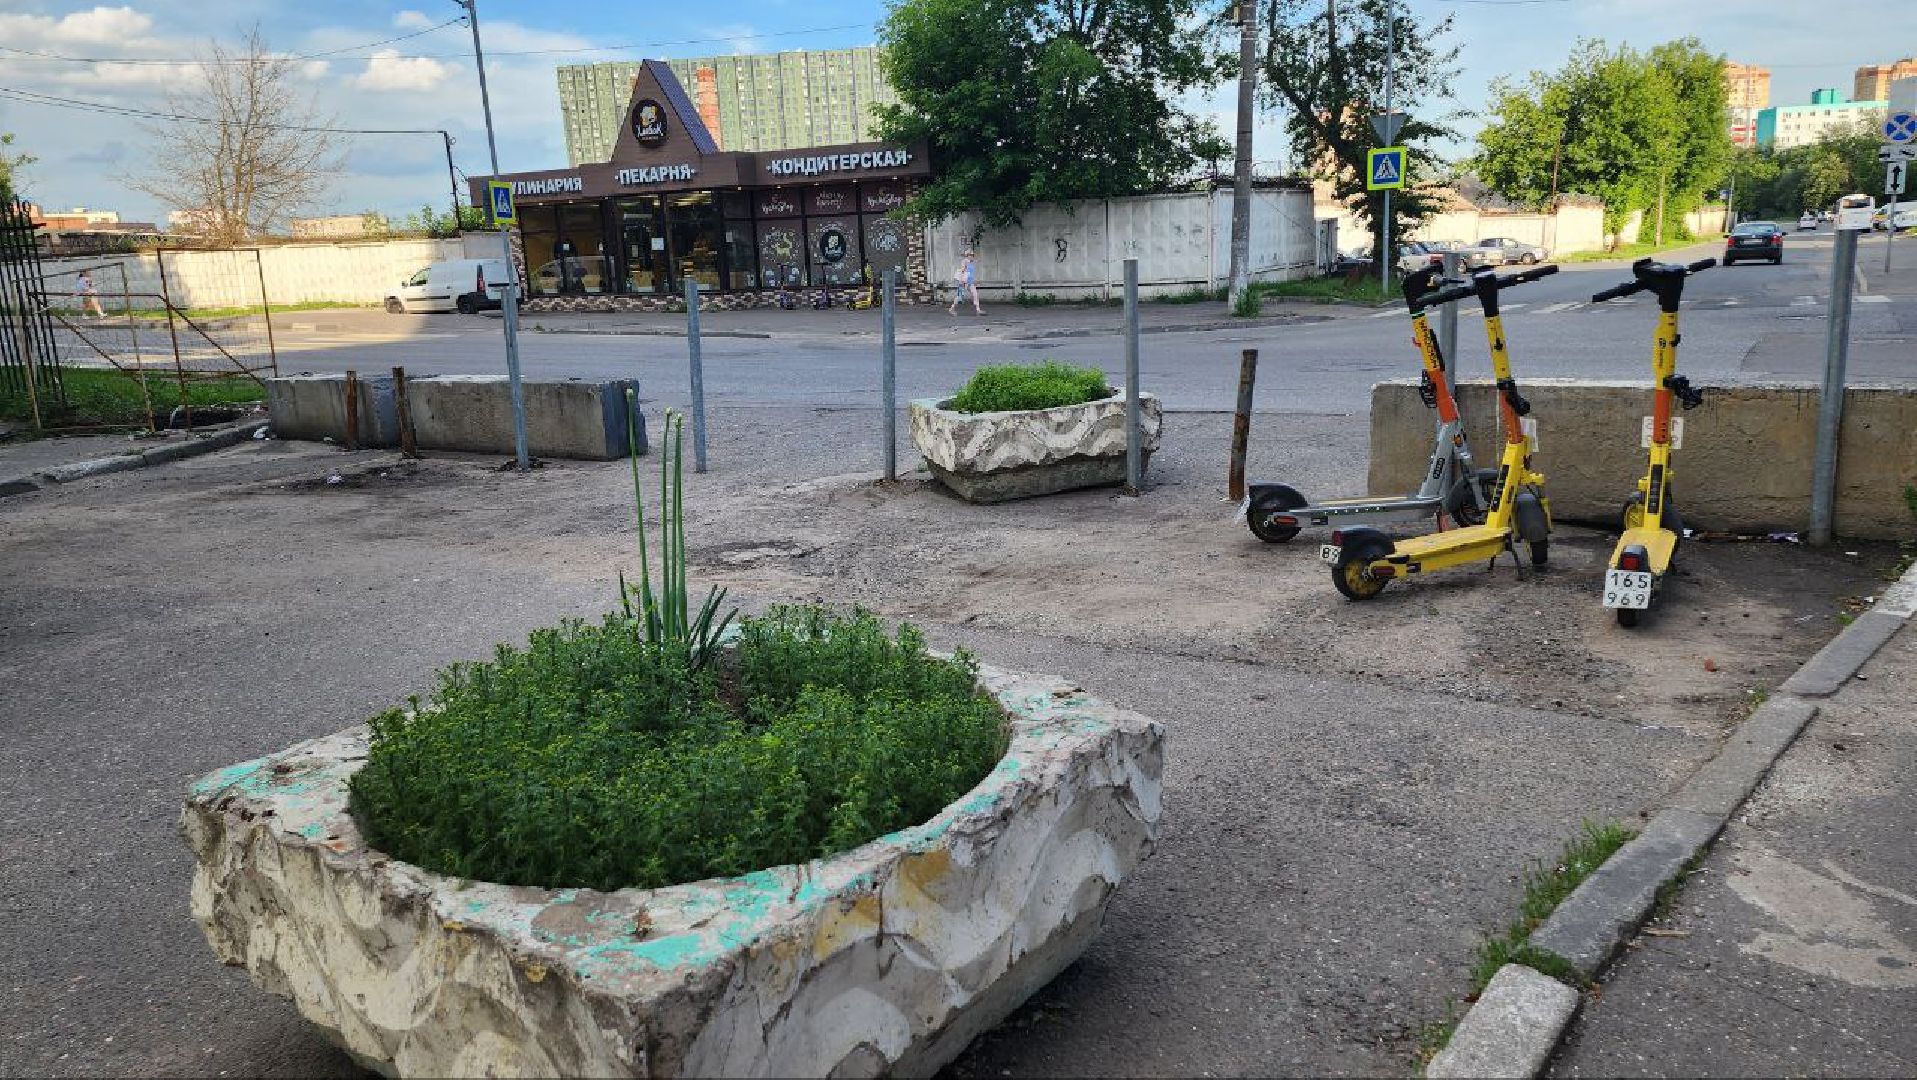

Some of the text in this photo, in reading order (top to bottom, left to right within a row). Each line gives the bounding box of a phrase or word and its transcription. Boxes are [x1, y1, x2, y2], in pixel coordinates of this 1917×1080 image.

[771, 150, 907, 176] КОНДИТЕРСКАЯ
[619, 163, 691, 185] ПЕКАРНЯ
[511, 177, 582, 195] УЛИНАРИЯ
[1611, 572, 1648, 589] 165
[1607, 592, 1646, 607] 969
